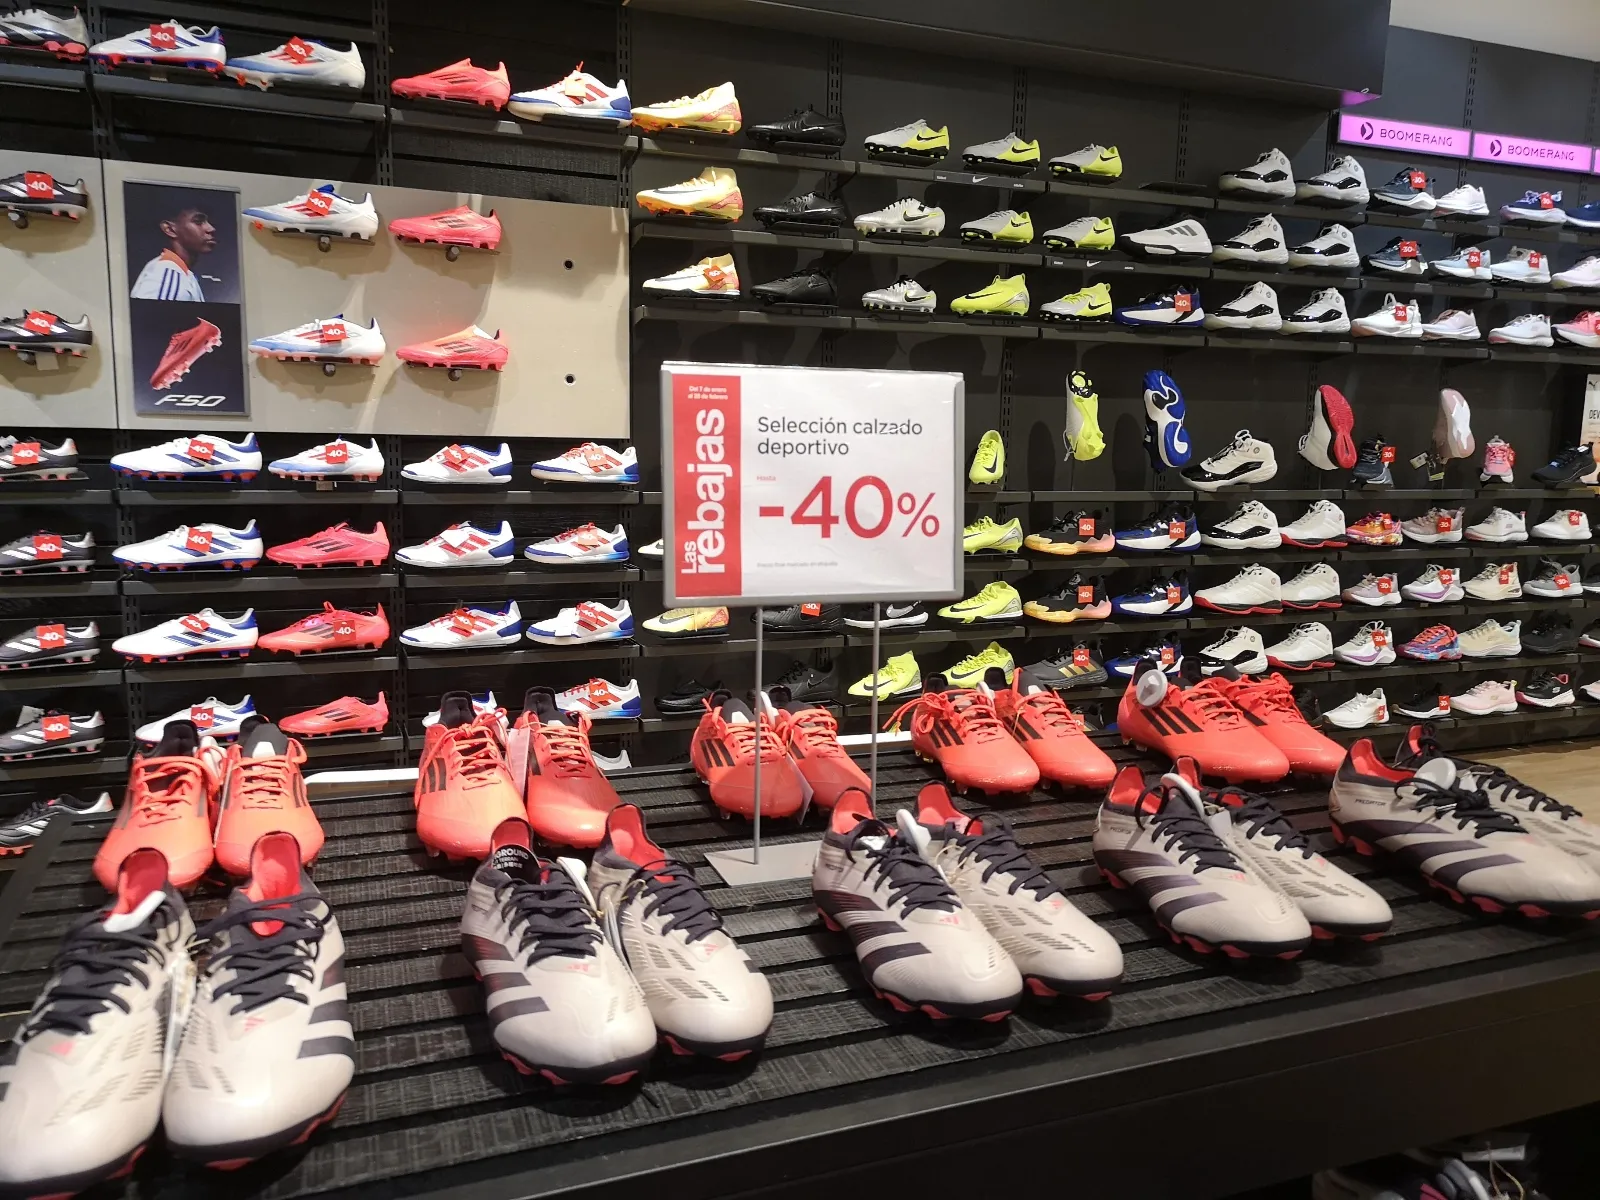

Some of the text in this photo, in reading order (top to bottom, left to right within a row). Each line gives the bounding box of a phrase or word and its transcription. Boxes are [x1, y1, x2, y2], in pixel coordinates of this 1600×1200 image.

[1380, 128, 1453, 146] BOOMERANG
[1508, 145, 1575, 161] BOOMERANG
[758, 416, 923, 436] Selección calzado
[757, 438, 849, 458] deportivo
[687, 408, 733, 573] rebajas
[759, 475, 940, 539] -40%
[681, 541, 697, 574] Las
